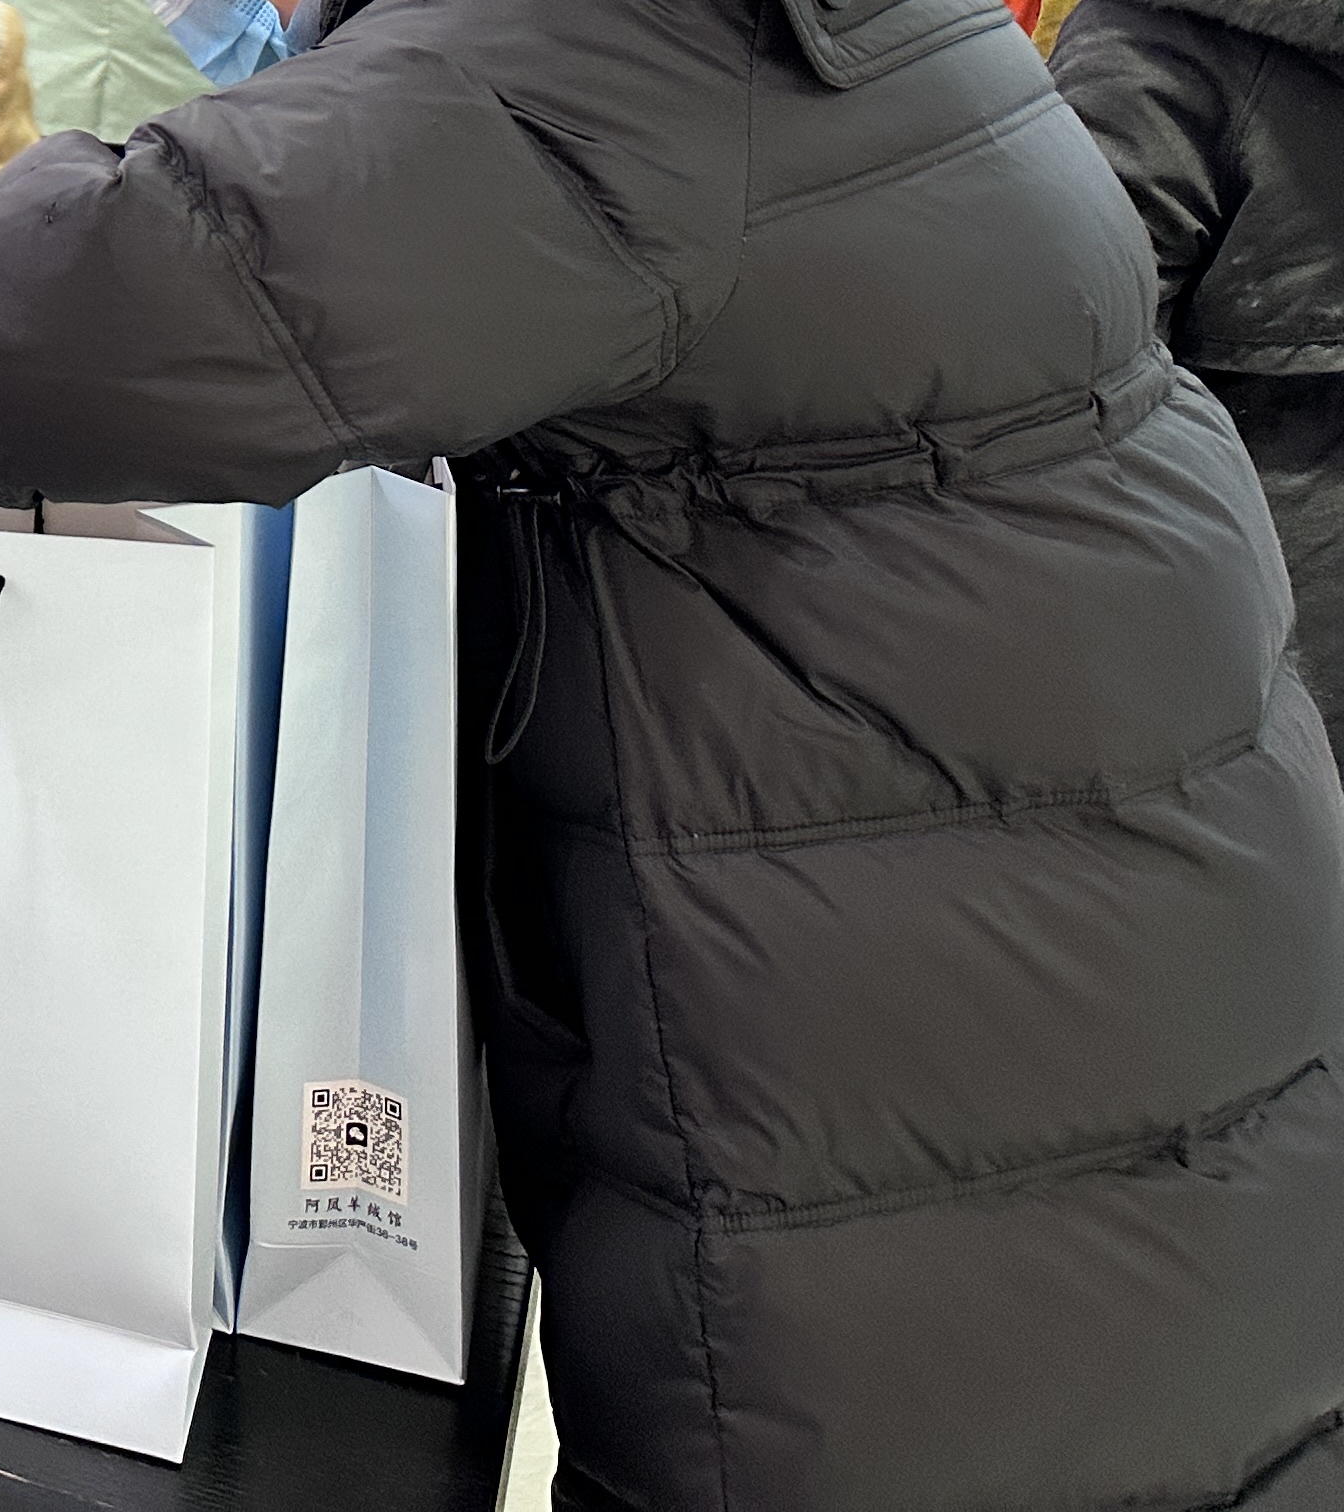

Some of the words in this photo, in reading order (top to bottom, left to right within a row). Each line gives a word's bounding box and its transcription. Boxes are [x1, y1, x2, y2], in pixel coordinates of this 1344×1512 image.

[305, 1194, 403, 1228] 阿凤羊绒馆
